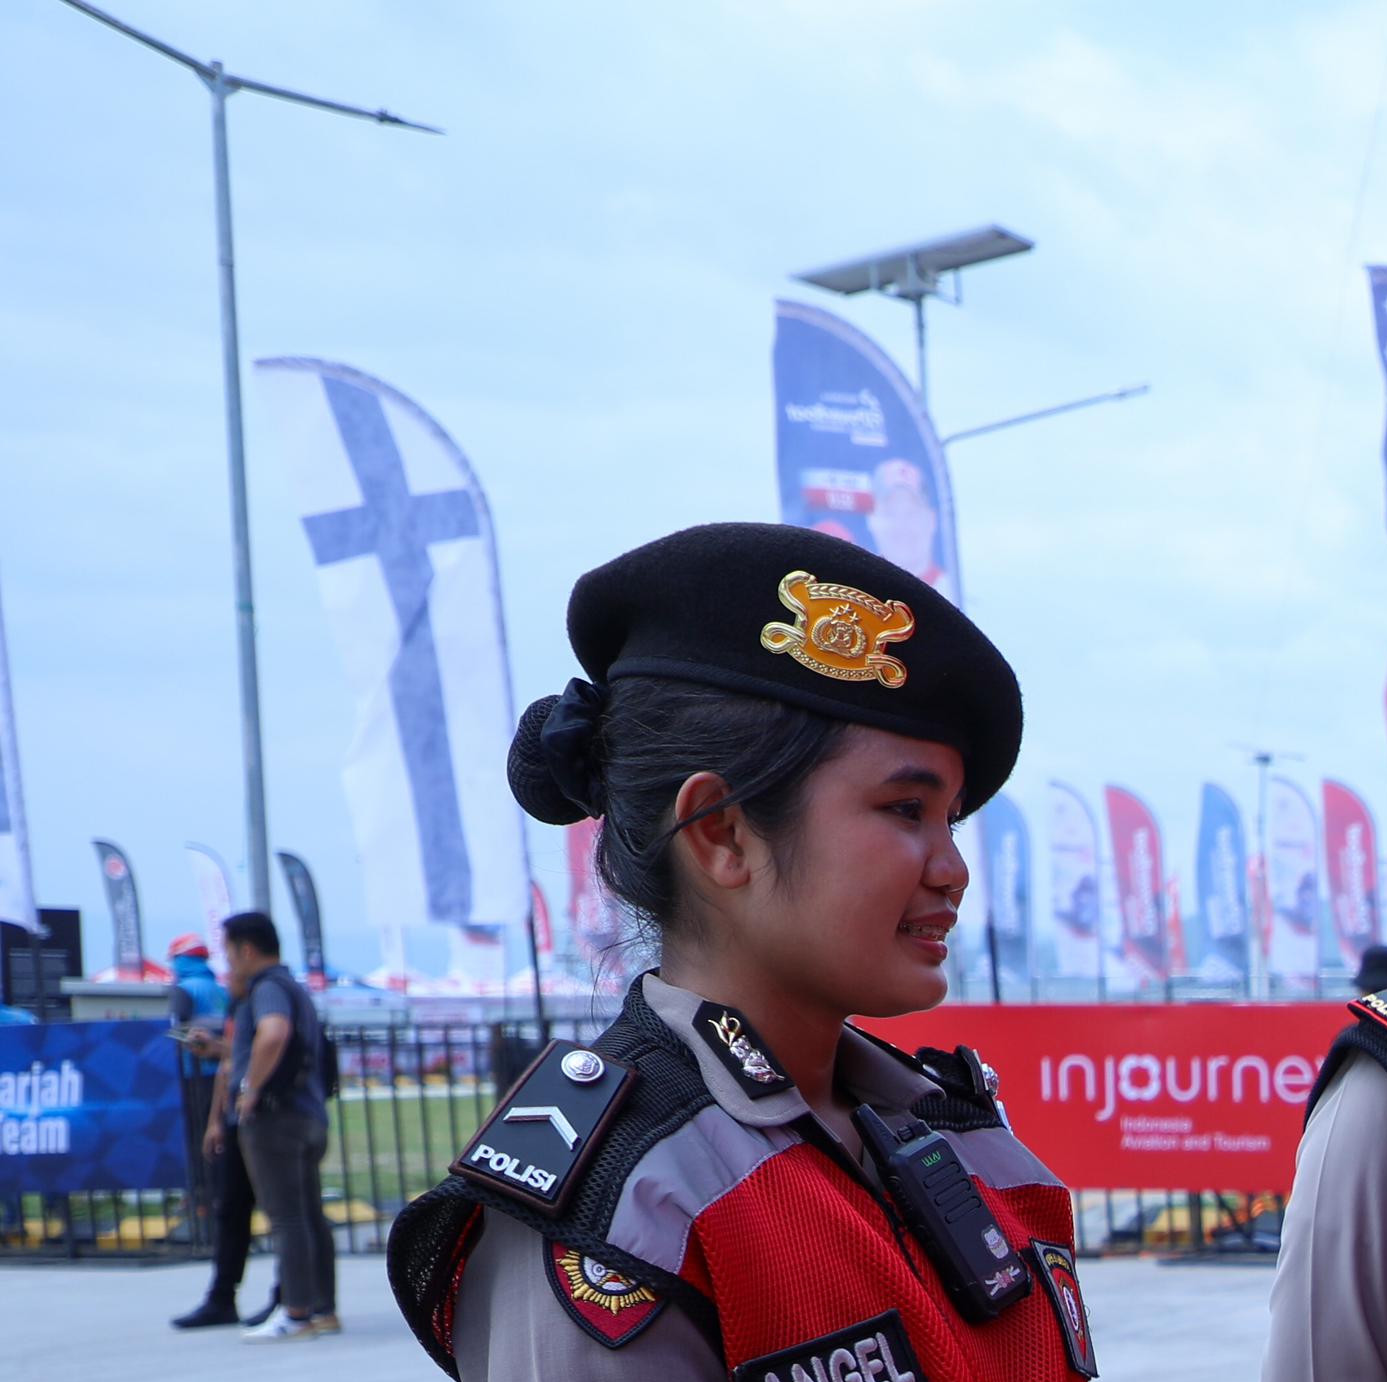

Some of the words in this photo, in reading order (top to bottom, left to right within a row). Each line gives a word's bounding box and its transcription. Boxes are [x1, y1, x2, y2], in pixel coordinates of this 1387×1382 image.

[1040, 1053, 1326, 1122] injourne
[0, 1111, 71, 1155] eam
[471, 1144, 557, 1193] POLISI
